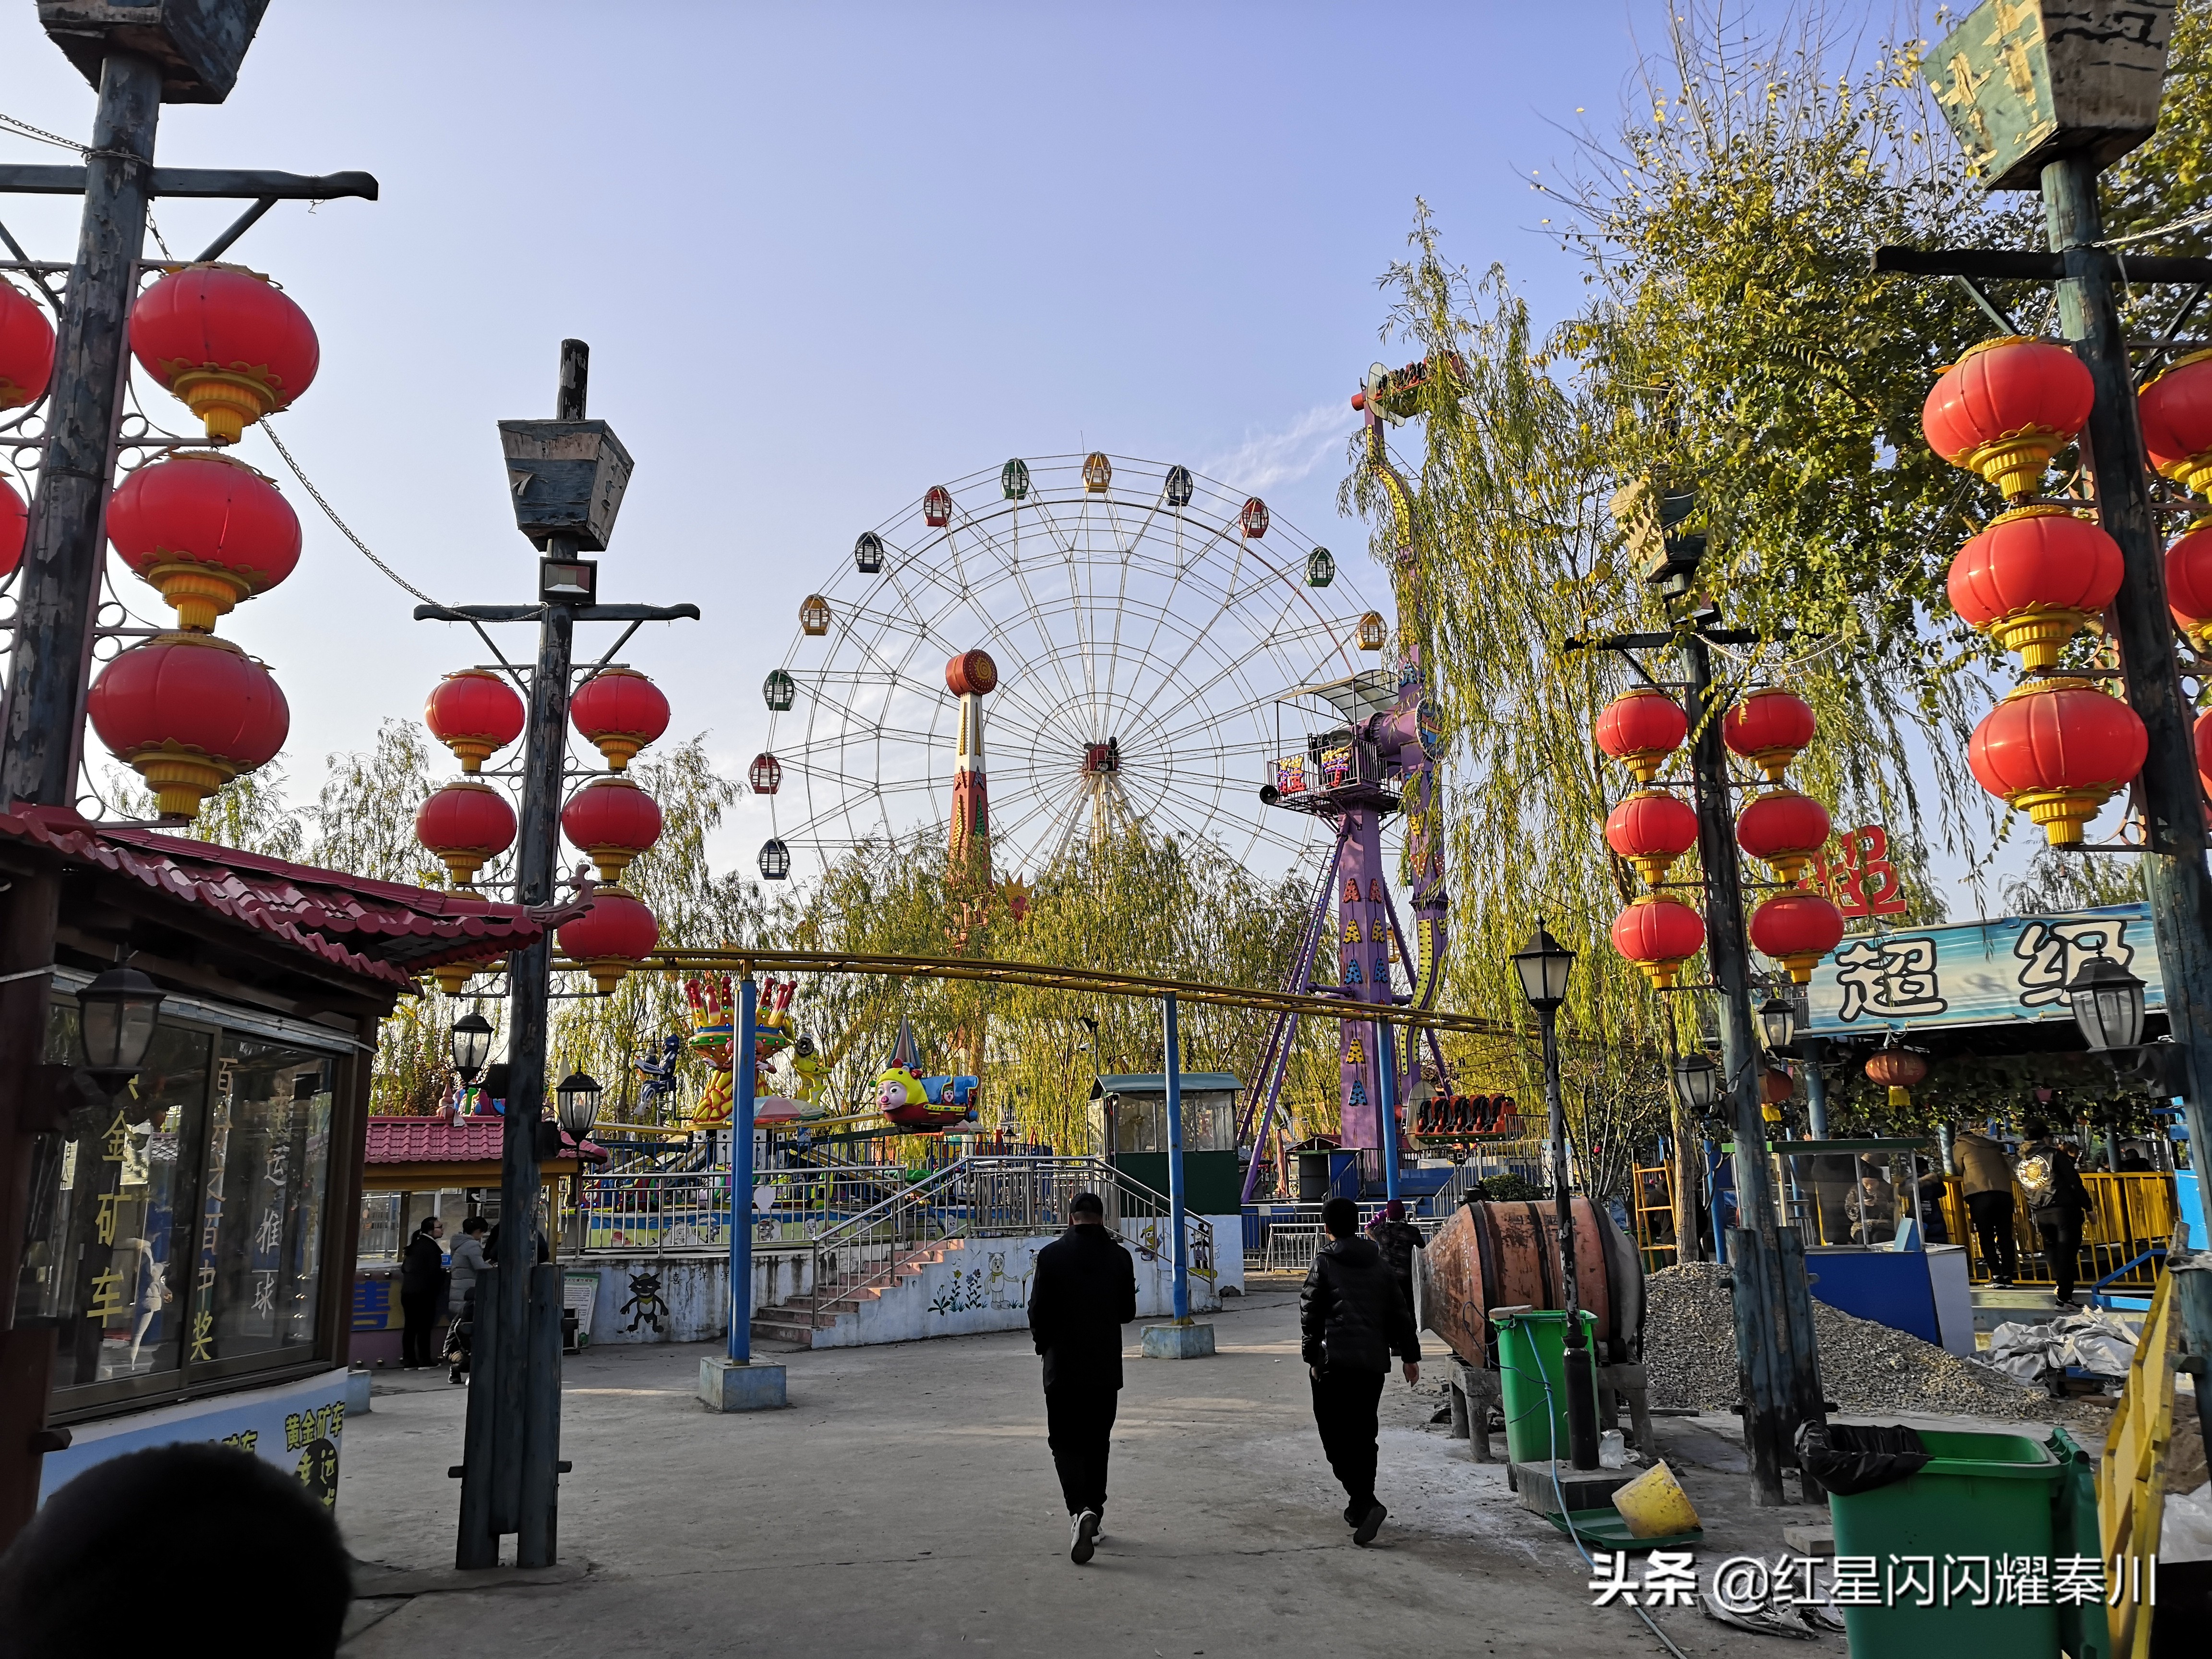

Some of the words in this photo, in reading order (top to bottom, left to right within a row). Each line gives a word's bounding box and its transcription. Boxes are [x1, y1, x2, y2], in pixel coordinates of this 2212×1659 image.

[86, 1074, 139, 1328] 金矿车
[670, 1271, 730, 1285] 喜洋洋
[285, 1400, 346, 1453] 黄金矿车
